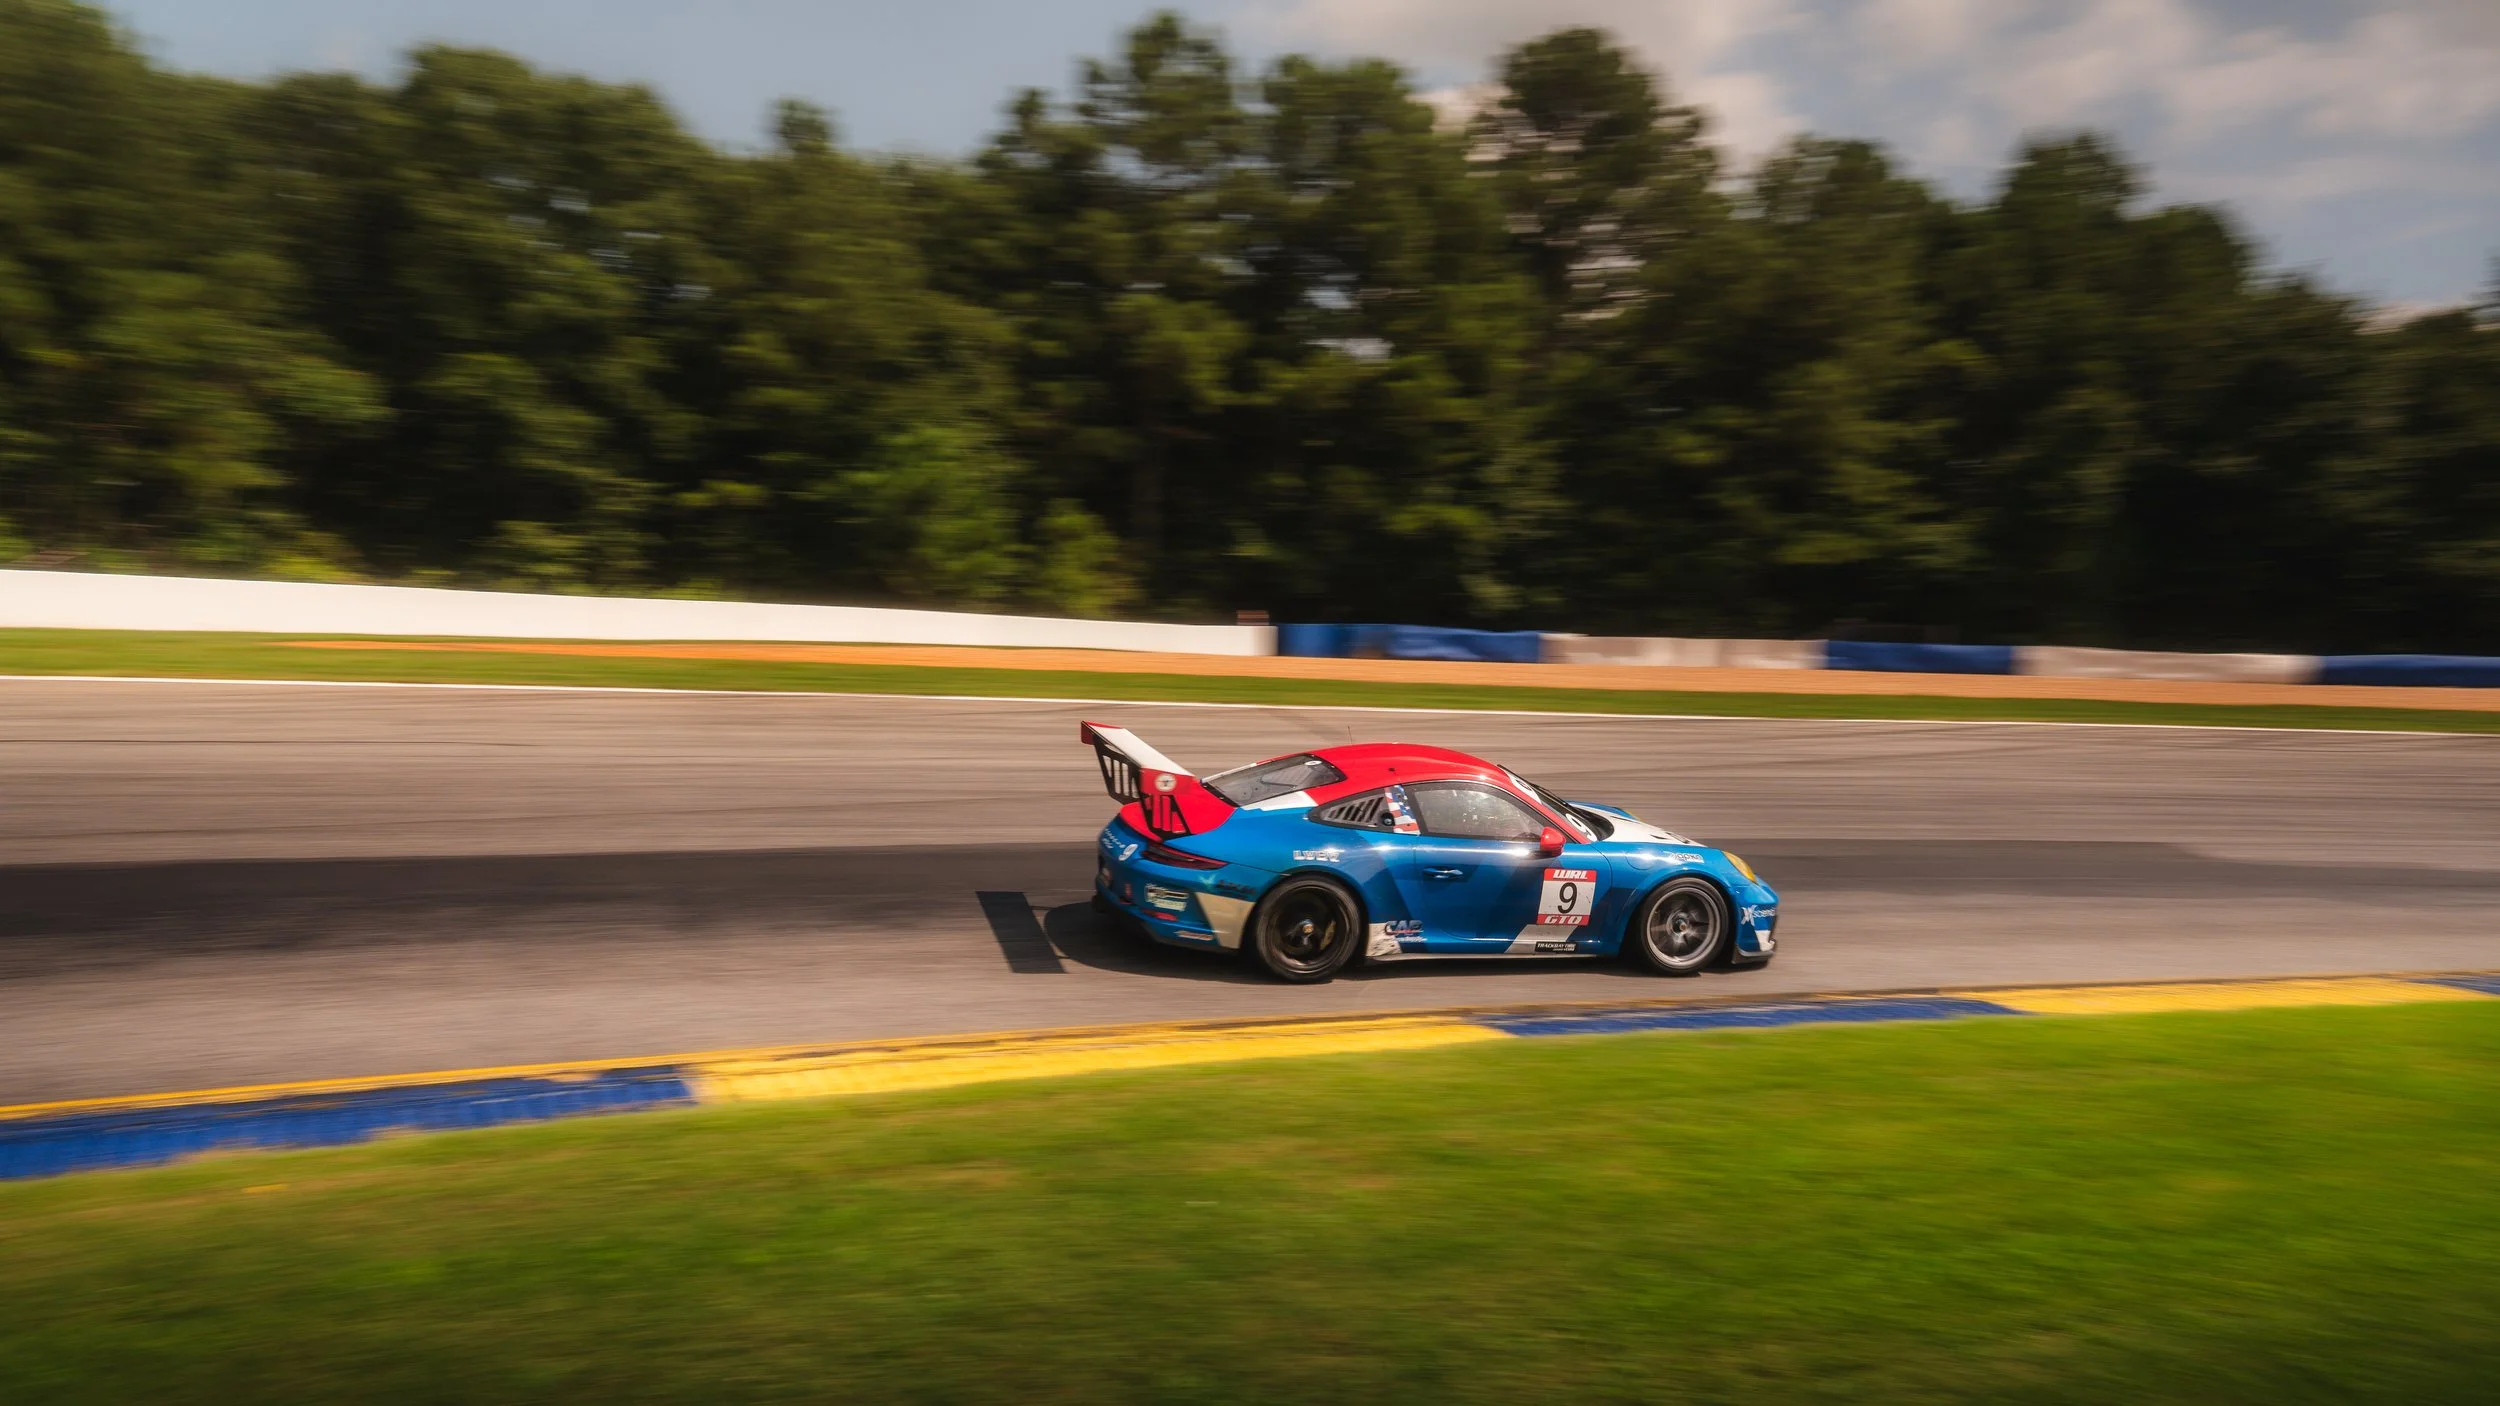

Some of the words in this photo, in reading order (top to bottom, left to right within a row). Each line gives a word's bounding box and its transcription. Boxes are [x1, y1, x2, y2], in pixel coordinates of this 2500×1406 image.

[1118, 843, 1139, 861] 9
[1553, 869, 1588, 880] WRL
[1557, 882, 1578, 914] 9
[1544, 915, 1583, 925] GTO
